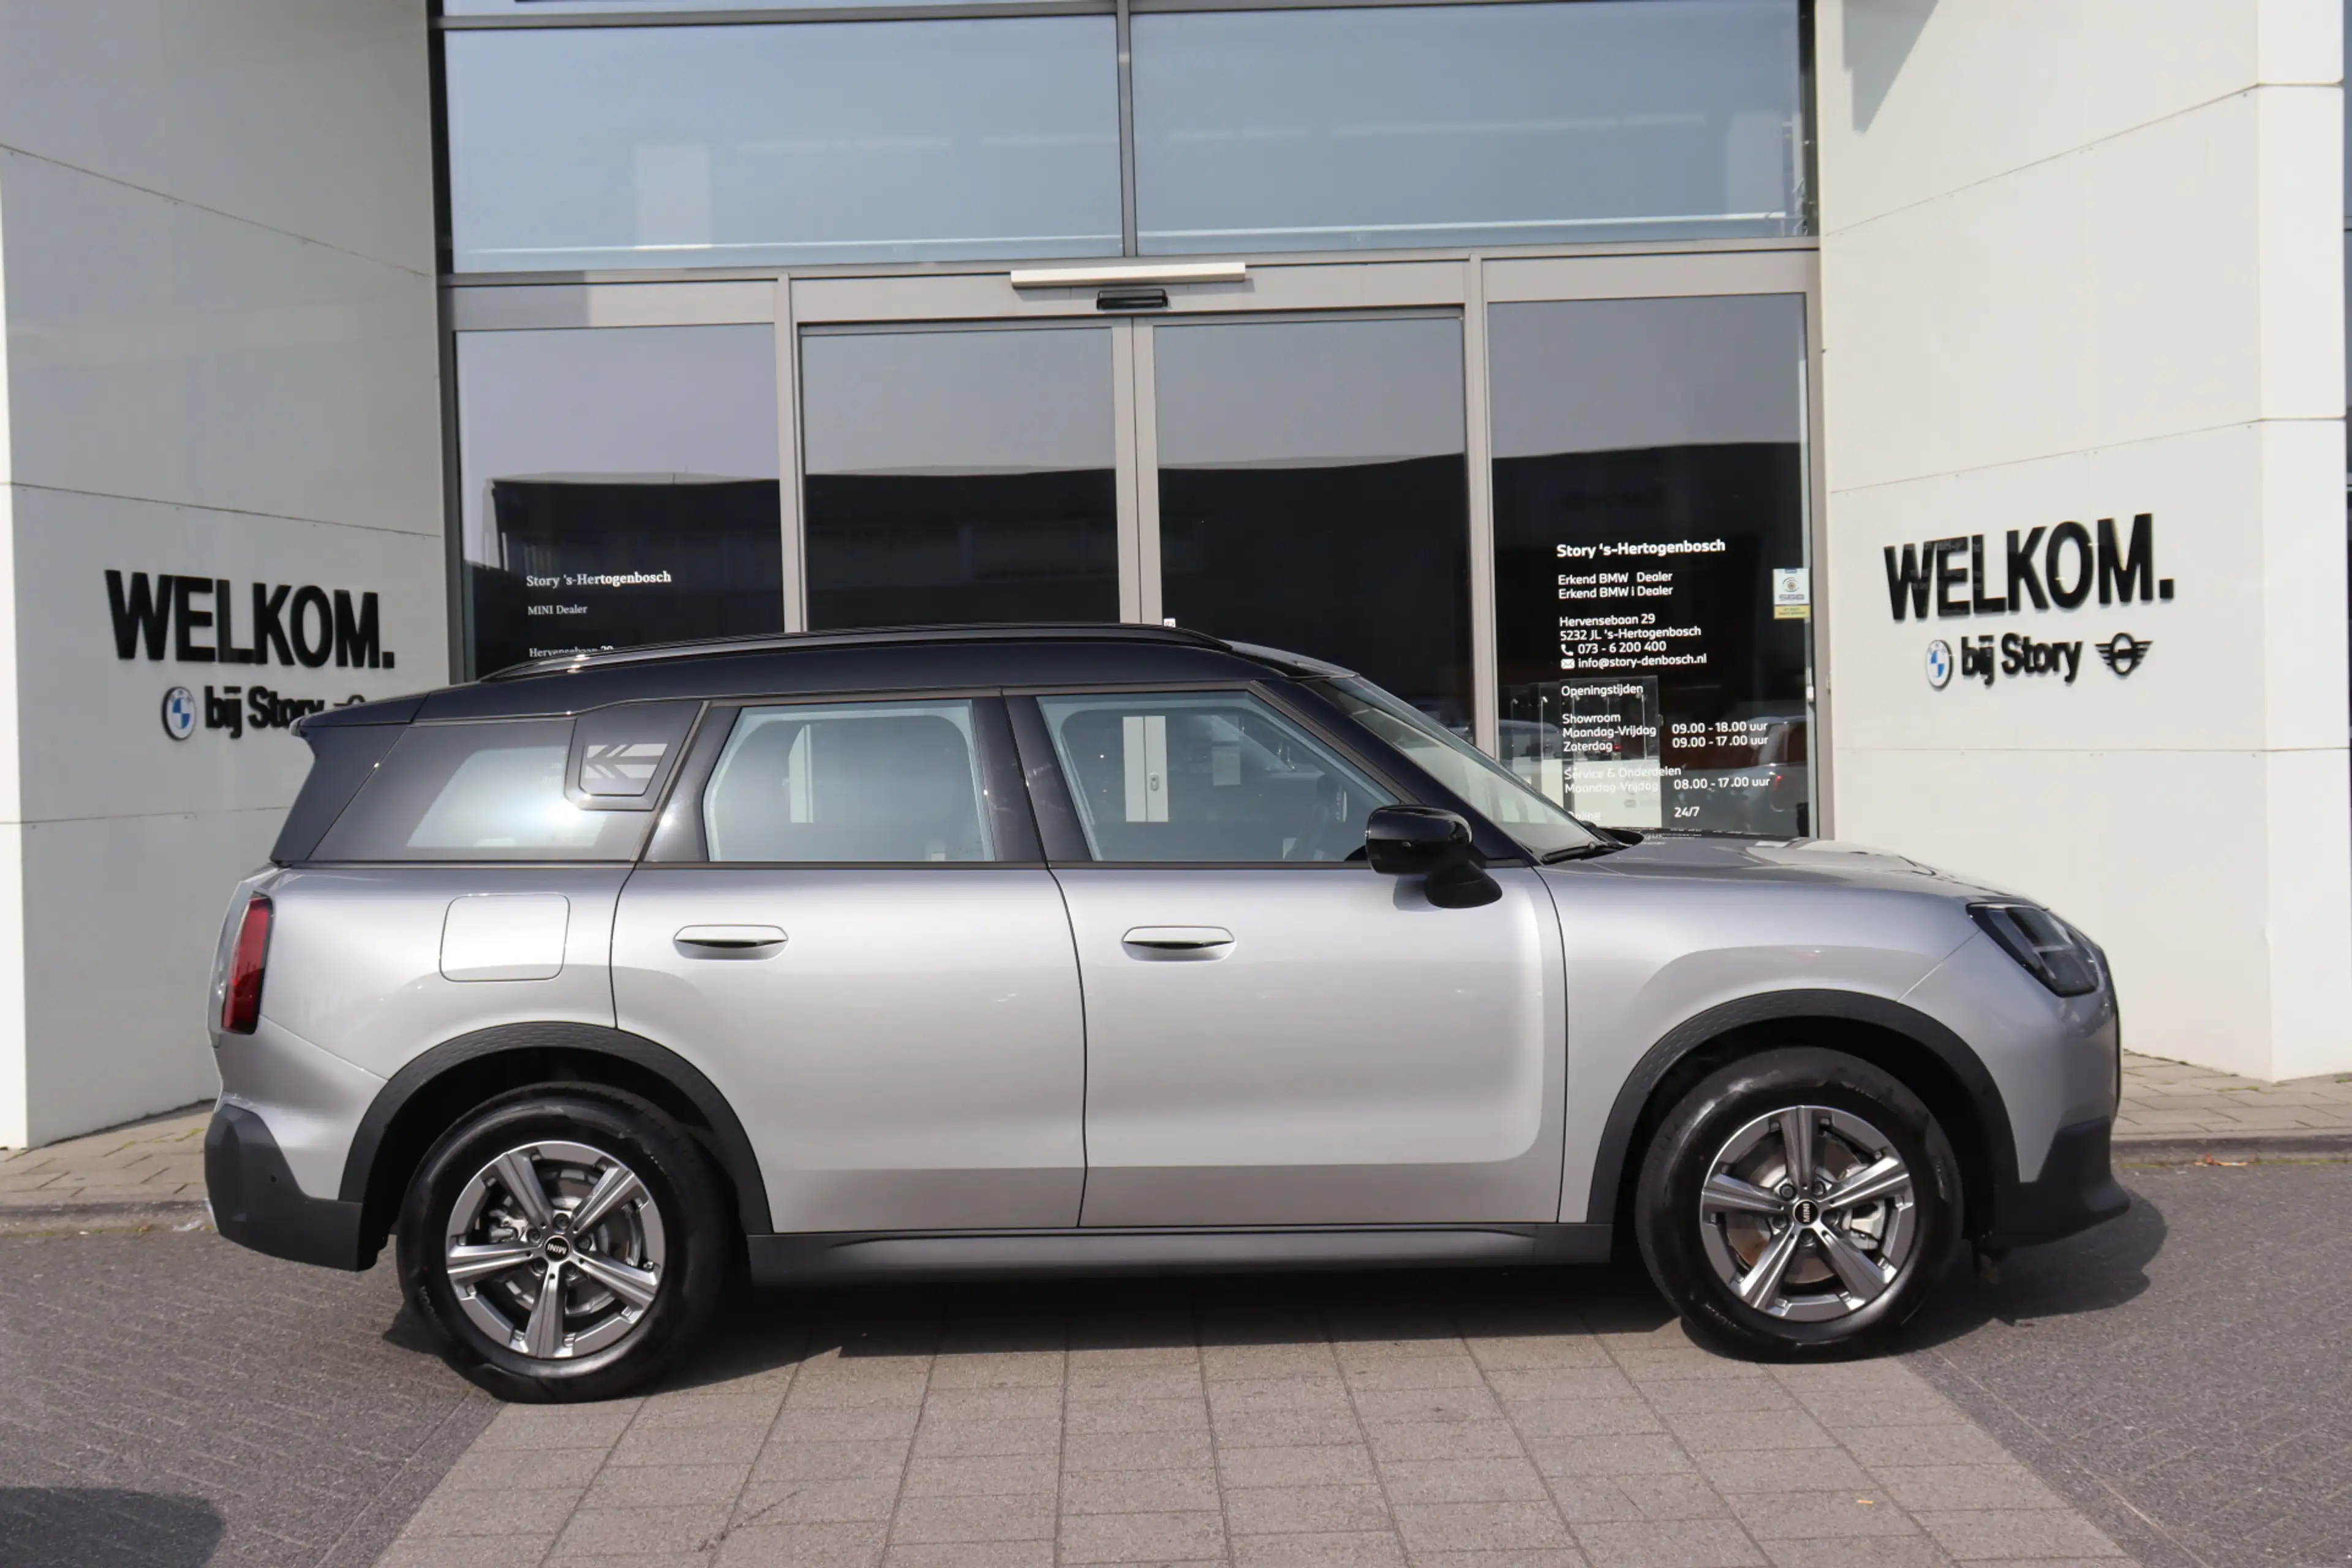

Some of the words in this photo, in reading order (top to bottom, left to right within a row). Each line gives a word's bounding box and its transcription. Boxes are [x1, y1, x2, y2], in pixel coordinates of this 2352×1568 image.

[1557, 544, 1596, 559] Story
[1883, 513, 2174, 620] WELKOM.
[526, 575, 560, 589] Story
[1558, 573, 1596, 585] Erkend
[1599, 572, 1629, 584] BMW
[1637, 571, 1673, 582] Dealer
[1558, 587, 1597, 599] Erkend
[1599, 586, 1629, 598] BMW
[1631, 586, 1635, 596] i
[1637, 585, 1673, 597] Dealer
[527, 605, 554, 616] MINI
[556, 603, 588, 614] Dealer
[105, 569, 395, 668] WELKOM.
[1559, 614, 1638, 627] Hervensebaan
[1641, 613, 1656, 624] 29
[1560, 630, 1587, 641] 5232
[1589, 630, 1602, 641] JL
[1578, 643, 1598, 654] 073
[1609, 642, 1616, 653] 6
[1619, 641, 1641, 653] 200
[1644, 641, 1667, 652] 400
[1578, 654, 1707, 669] info@story-denbosch.nl
[2001, 632, 2084, 683] Story
[1561, 684, 1643, 698] Openingstijden
[1562, 714, 1621, 724] Showroom
[1562, 725, 1657, 738] Maandag-Vrijdag
[1672, 723, 1706, 734] 09.00
[1715, 721, 1747, 733] 18.00
[1749, 722, 1768, 731] uur
[1563, 741, 1613, 753] Zaterdag
[1672, 736, 1706, 748] 09.00
[1750, 736, 1769, 745] uur
[1564, 769, 1604, 780] Service
[1618, 766, 1681, 778] Onderdelen
[1673, 778, 1708, 790] 08.00
[1752, 777, 1770, 786] uur
[1674, 806, 1700, 818] 24/7
